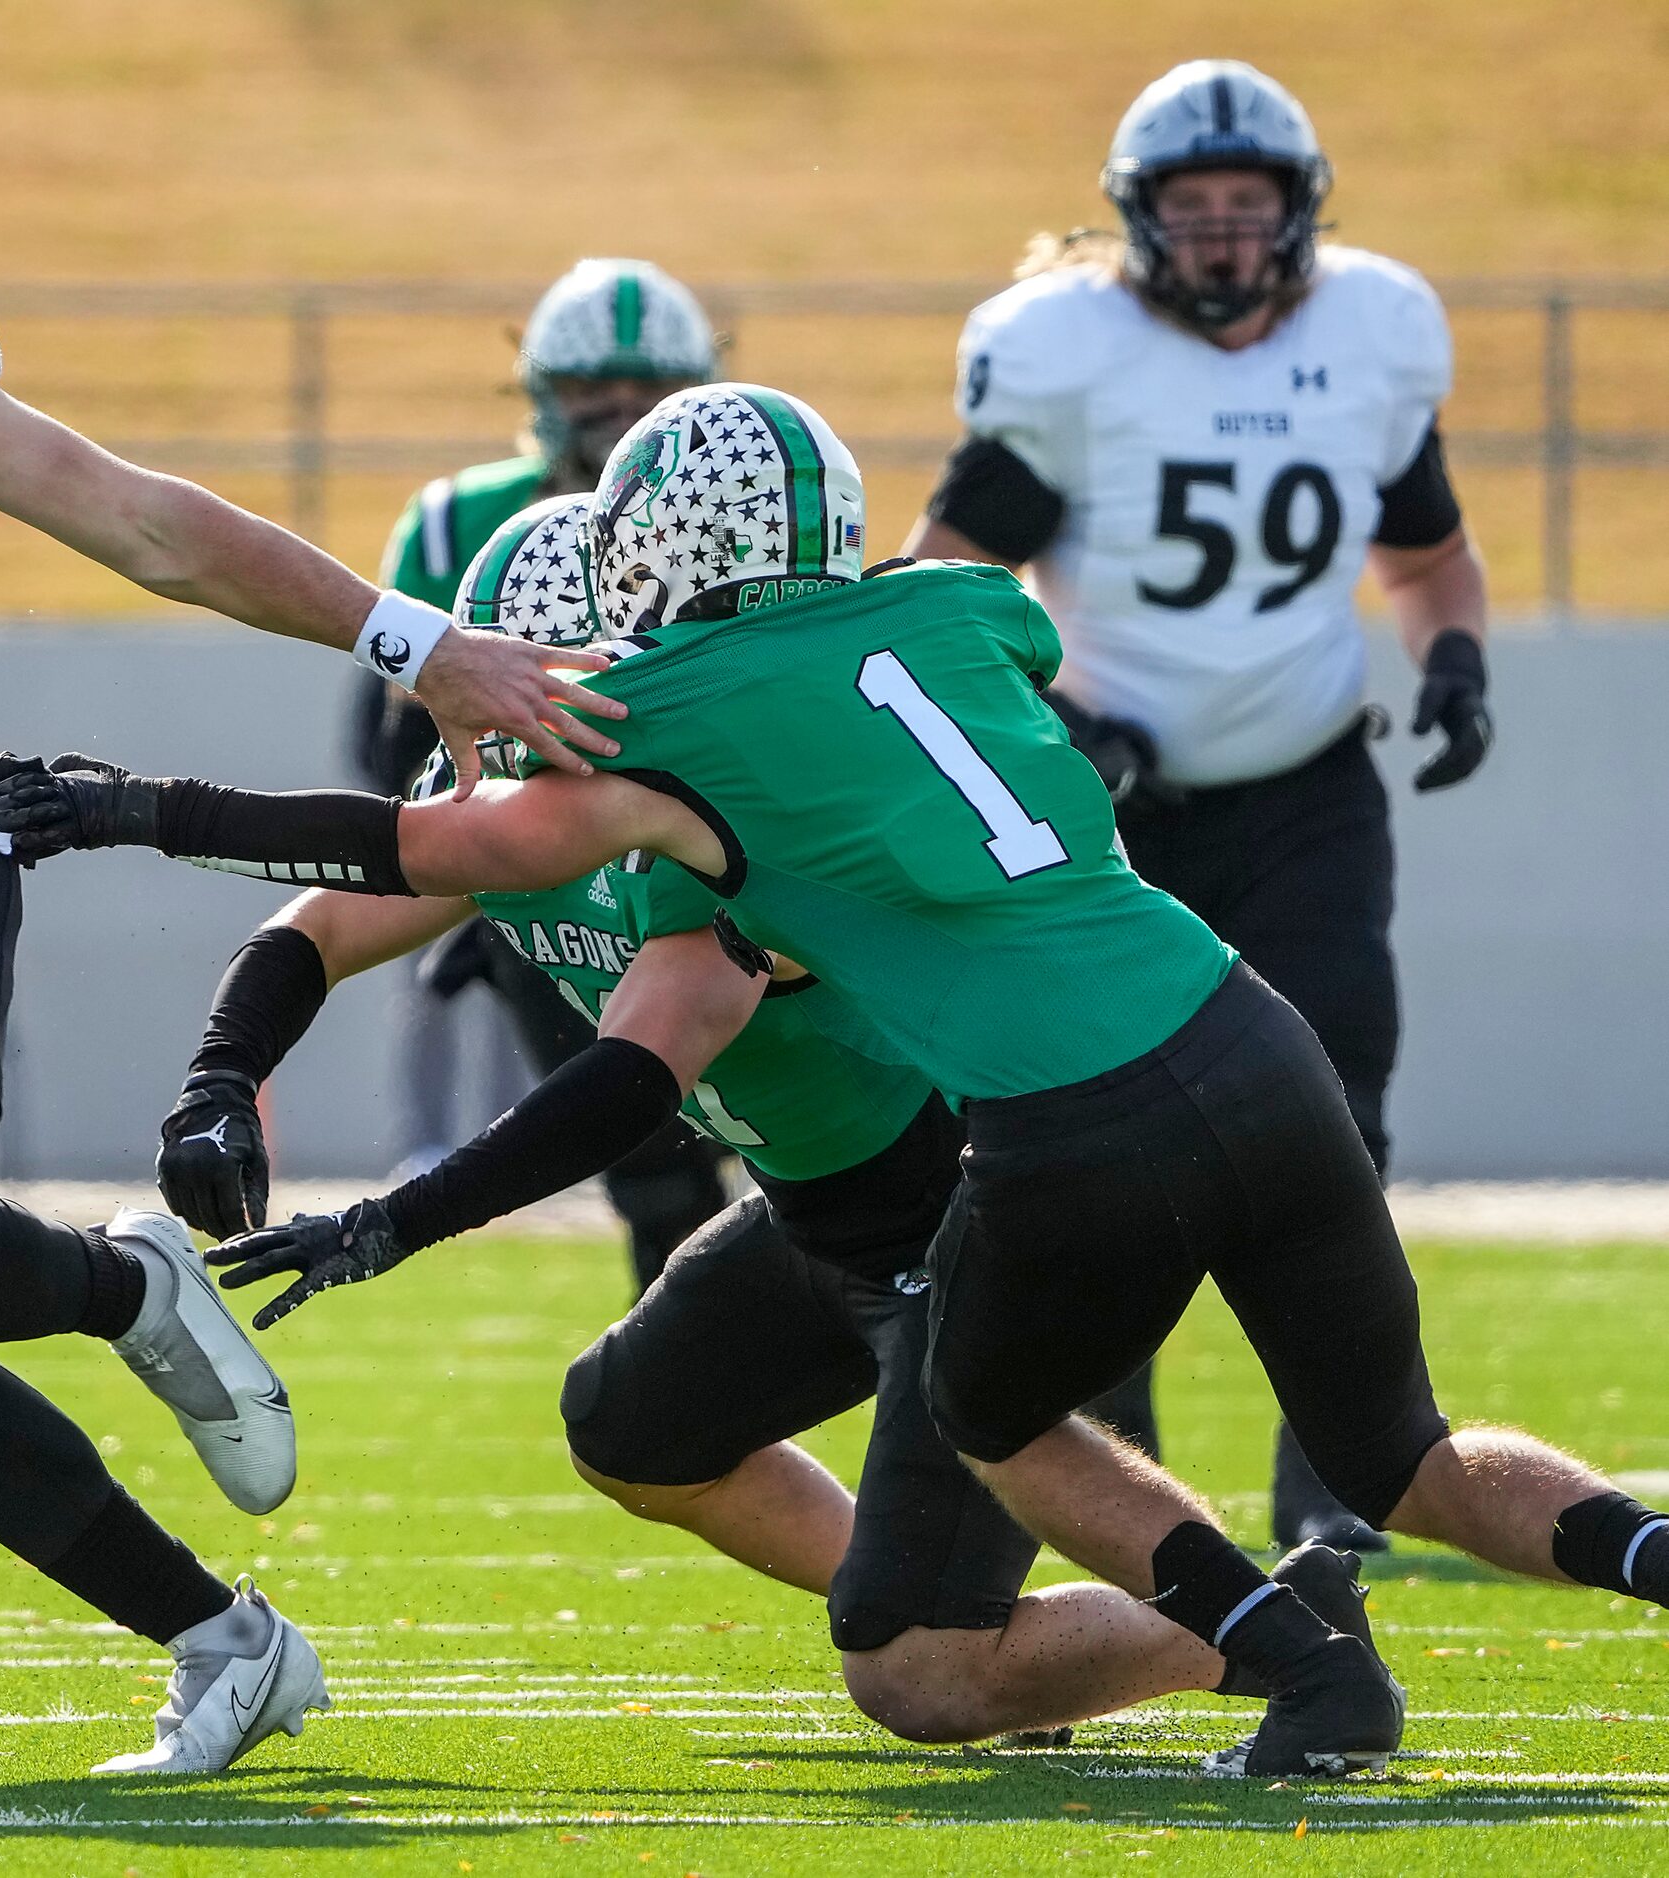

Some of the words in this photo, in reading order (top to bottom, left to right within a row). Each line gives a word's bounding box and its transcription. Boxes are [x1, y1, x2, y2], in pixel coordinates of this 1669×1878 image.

[833, 515, 843, 556] 1
[1135, 461, 1342, 615] 59
[854, 647, 1073, 884] 1
[494, 919, 638, 974] RAGONS
